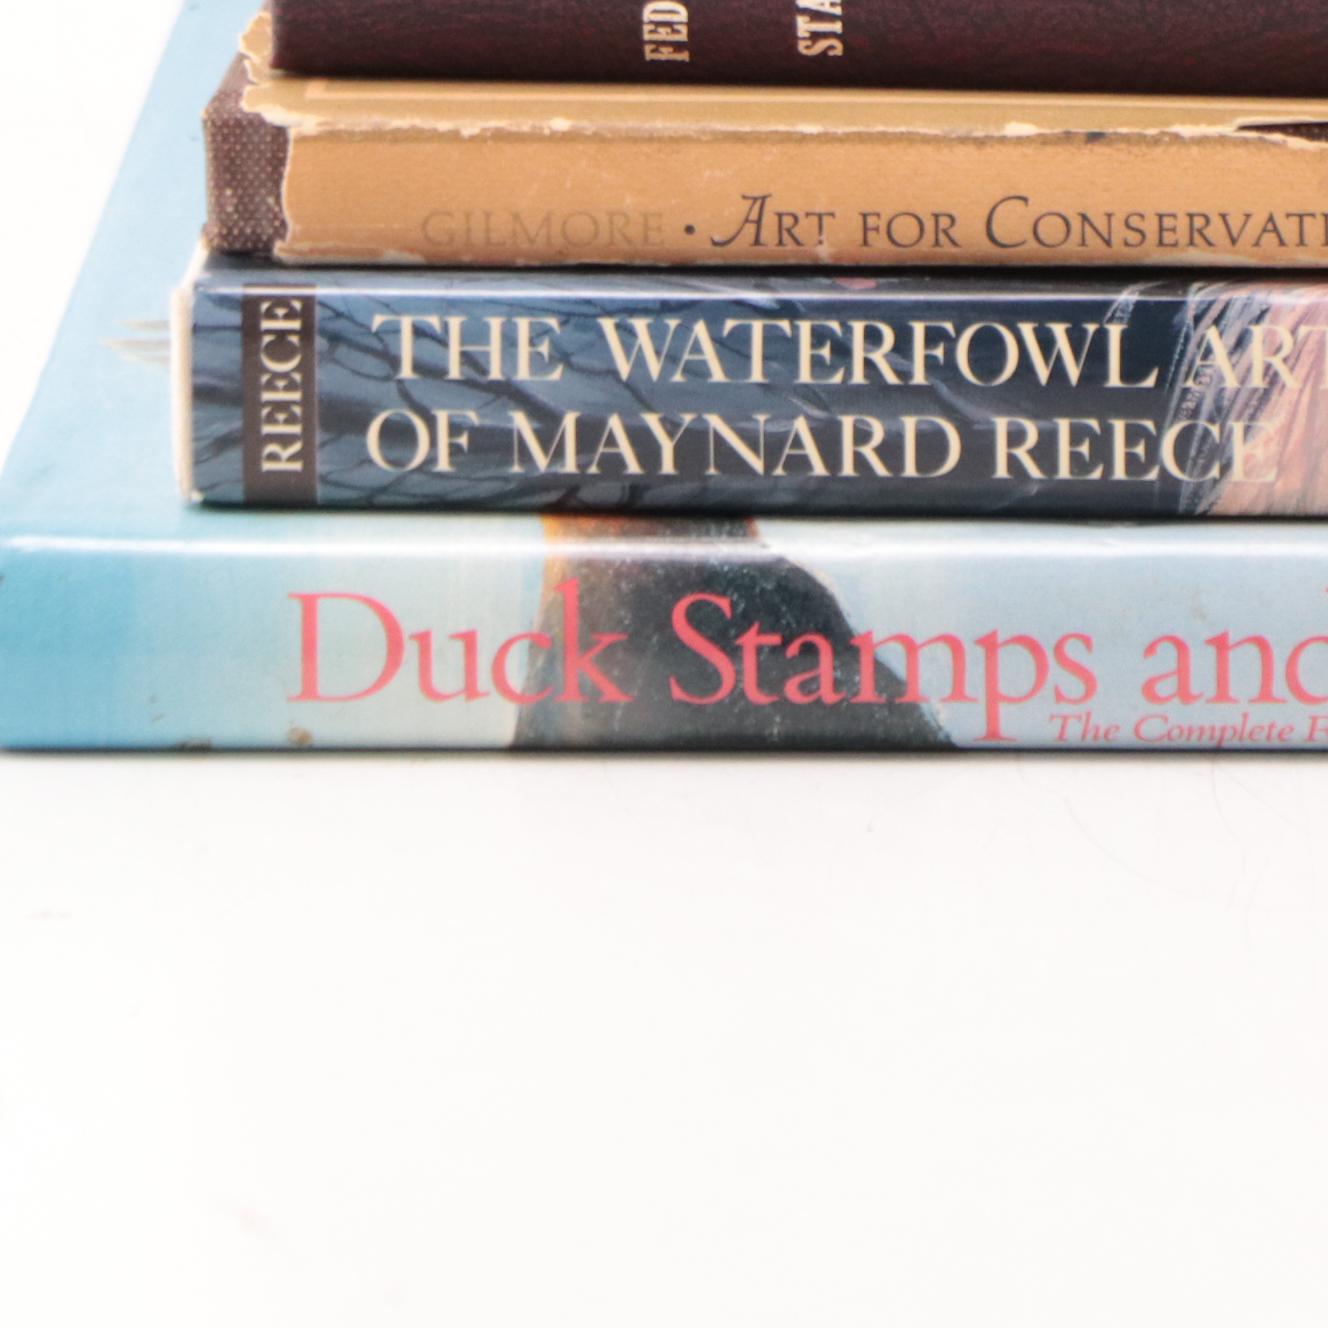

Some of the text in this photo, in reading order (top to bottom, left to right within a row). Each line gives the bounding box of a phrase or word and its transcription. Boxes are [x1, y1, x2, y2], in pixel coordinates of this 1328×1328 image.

[421, 209, 665, 250] GILMORE
[710, 193, 835, 249] ART
[858, 211, 962, 249] FOR
[260, 299, 303, 472] REECE
[371, 313, 565, 382] THE
[596, 315, 1159, 389] WATERFOWL
[366, 408, 1278, 482] OF MAYNARD REECE
[286, 578, 636, 705] Duck
[668, 591, 1100, 744] Stamps
[1050, 711, 1121, 743] The
[1134, 712, 1296, 748] Complete
